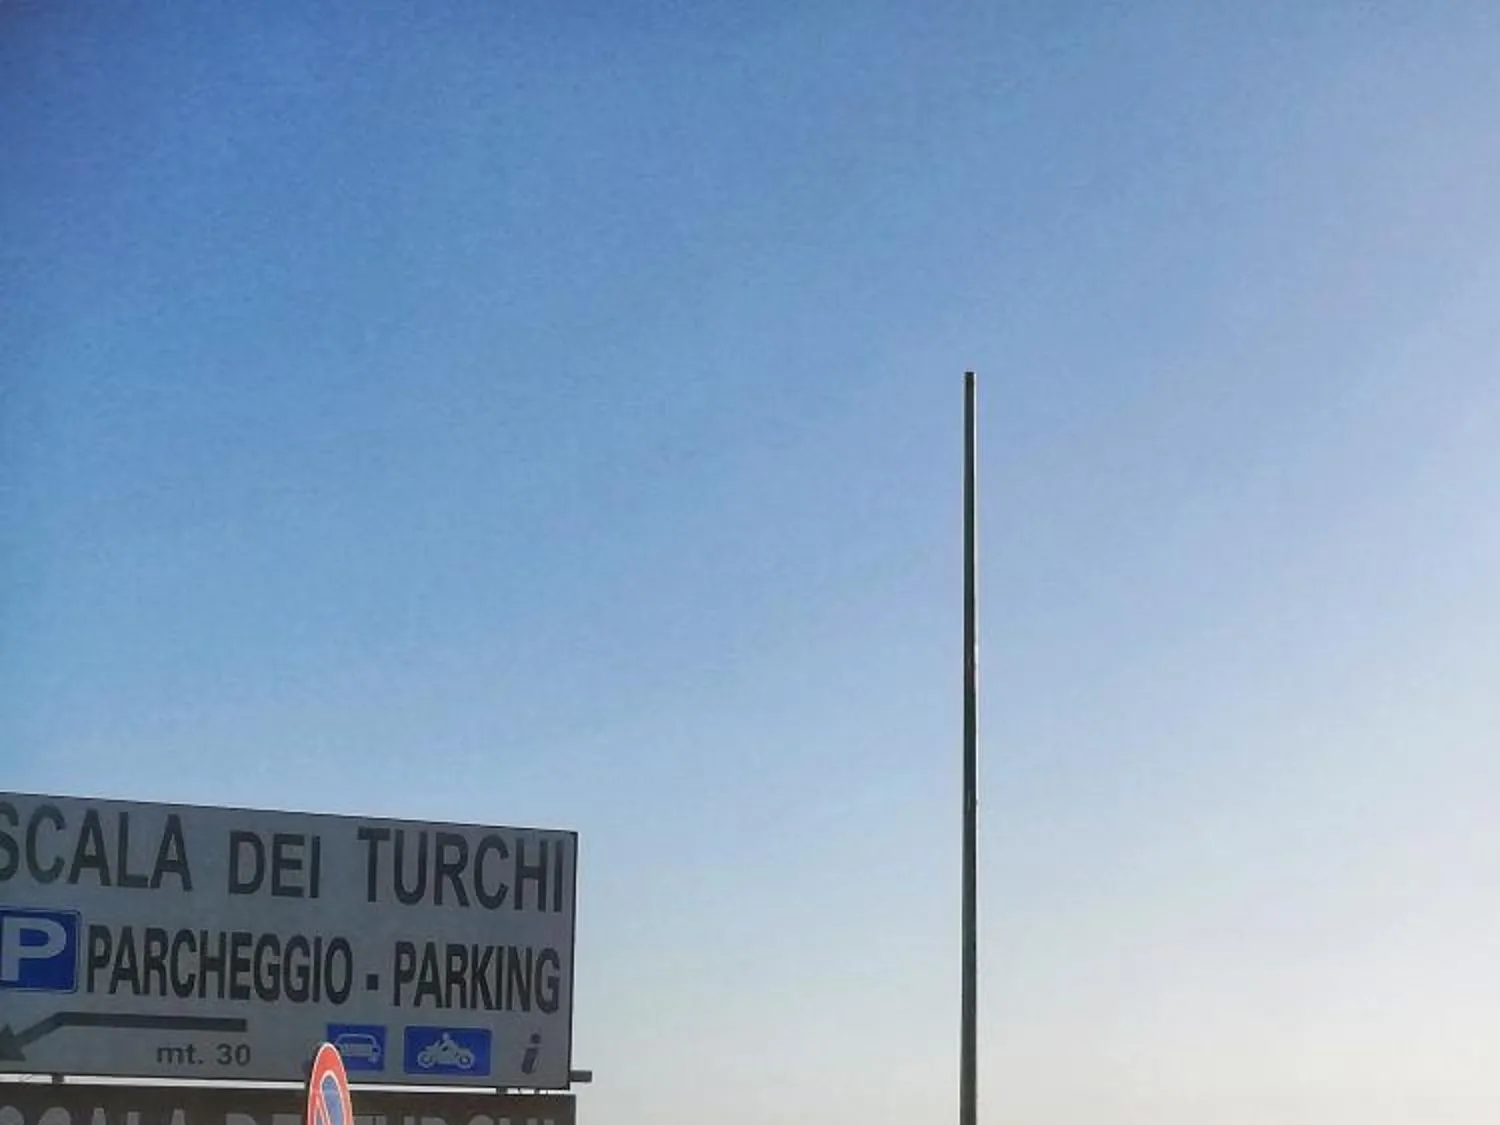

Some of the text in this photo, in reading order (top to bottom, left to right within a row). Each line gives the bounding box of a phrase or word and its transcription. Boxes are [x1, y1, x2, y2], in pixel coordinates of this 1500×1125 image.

[0, 801, 563, 914] SCALA DEI TURCHI
[1, 915, 67, 982] P
[87, 924, 352, 1005] PARCHEGGIO
[393, 940, 561, 1014] PARKING
[157, 1043, 251, 1066] mt. 30
